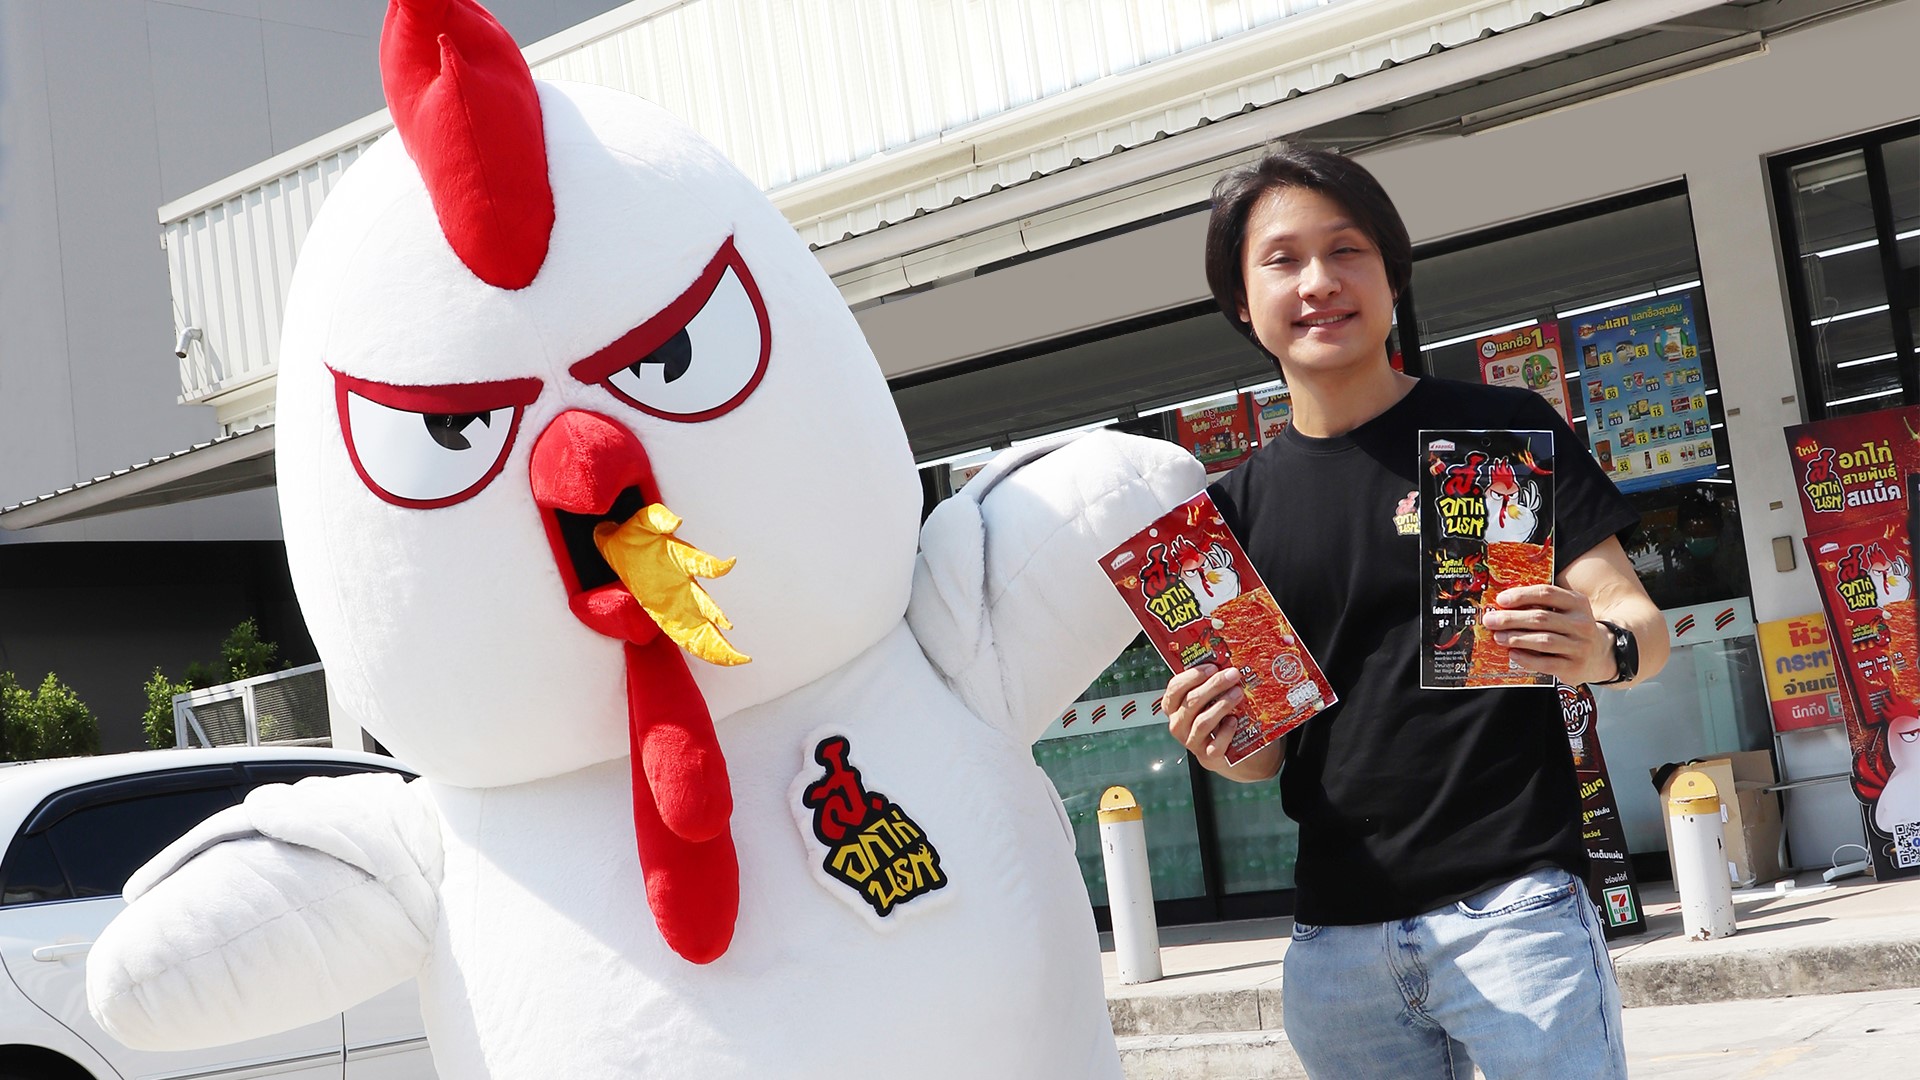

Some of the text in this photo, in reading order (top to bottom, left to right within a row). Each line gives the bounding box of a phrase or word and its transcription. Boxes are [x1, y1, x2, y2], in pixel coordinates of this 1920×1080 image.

[1496, 333, 1532, 352] แลกซื้อ
[1530, 327, 1544, 348] 1
[1796, 441, 1819, 457] ใหม่
[1839, 440, 1893, 469] อกไก่
[1843, 463, 1898, 485] สายพันธุ์
[1847, 480, 1902, 507] สแน็ค
[1440, 497, 1485, 517] อกไก่
[1446, 516, 1485, 537] นรก
[1149, 582, 1192, 616] อกไก่
[1164, 598, 1199, 628] นรก
[1240, 666, 1252, 676] 70
[1455, 663, 1467, 673] 24
[1776, 649, 1833, 675] กระห
[1792, 702, 1826, 719] นึกถึง
[1246, 727, 1258, 738] 24
[831, 810, 920, 883] อกไก่
[868, 843, 941, 909] นรก
